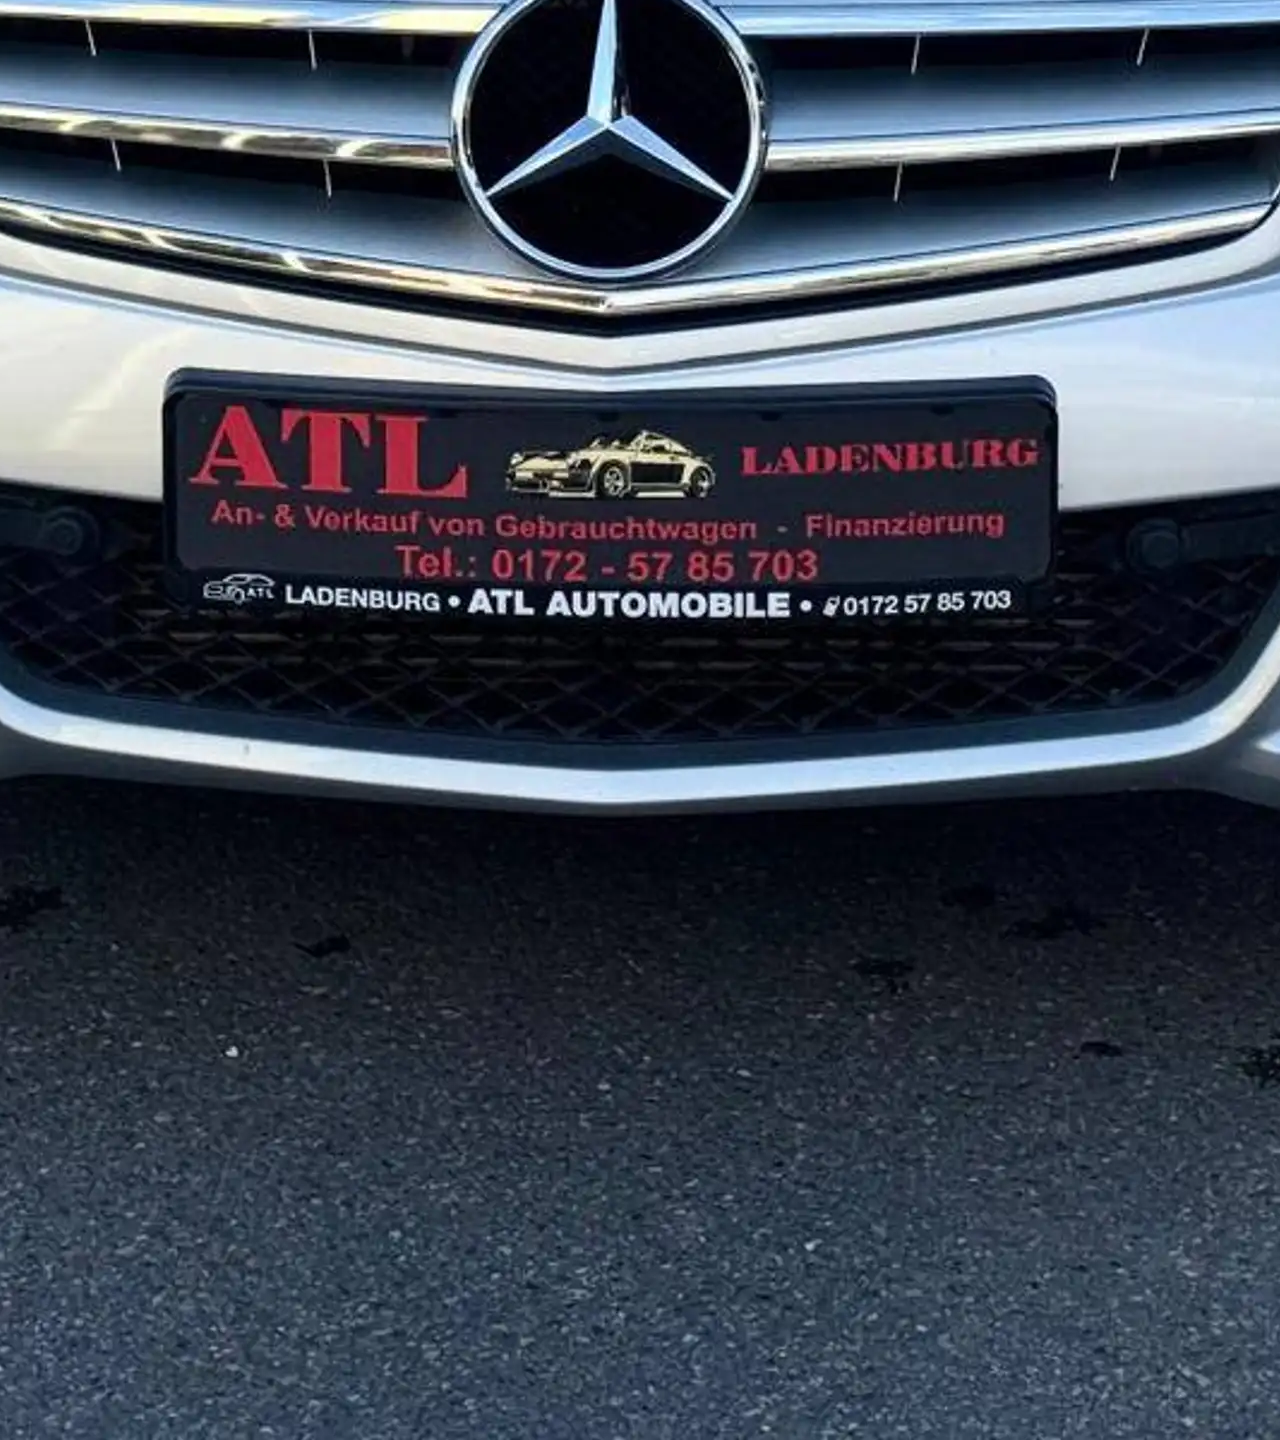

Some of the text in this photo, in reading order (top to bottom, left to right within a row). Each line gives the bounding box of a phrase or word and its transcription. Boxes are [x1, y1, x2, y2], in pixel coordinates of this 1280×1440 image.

[188, 405, 467, 498] ATL
[740, 438, 1040, 476] LADENBURG
[211, 499, 266, 525] An-
[274, 503, 296, 529] &
[304, 505, 420, 534] Verkauf
[427, 515, 485, 537] von
[495, 515, 758, 544] Gebrauchtwagen
[805, 511, 1005, 539] Finanzierung
[395, 544, 477, 579] Tel.:
[491, 549, 588, 582] 0172
[627, 550, 673, 582] 57
[687, 550, 734, 582] 85
[747, 548, 818, 582] 703
[246, 586, 275, 599] ATL
[284, 585, 1012, 618] LADENBURG ATL AUTOMOBILE 0172 57 85 703
